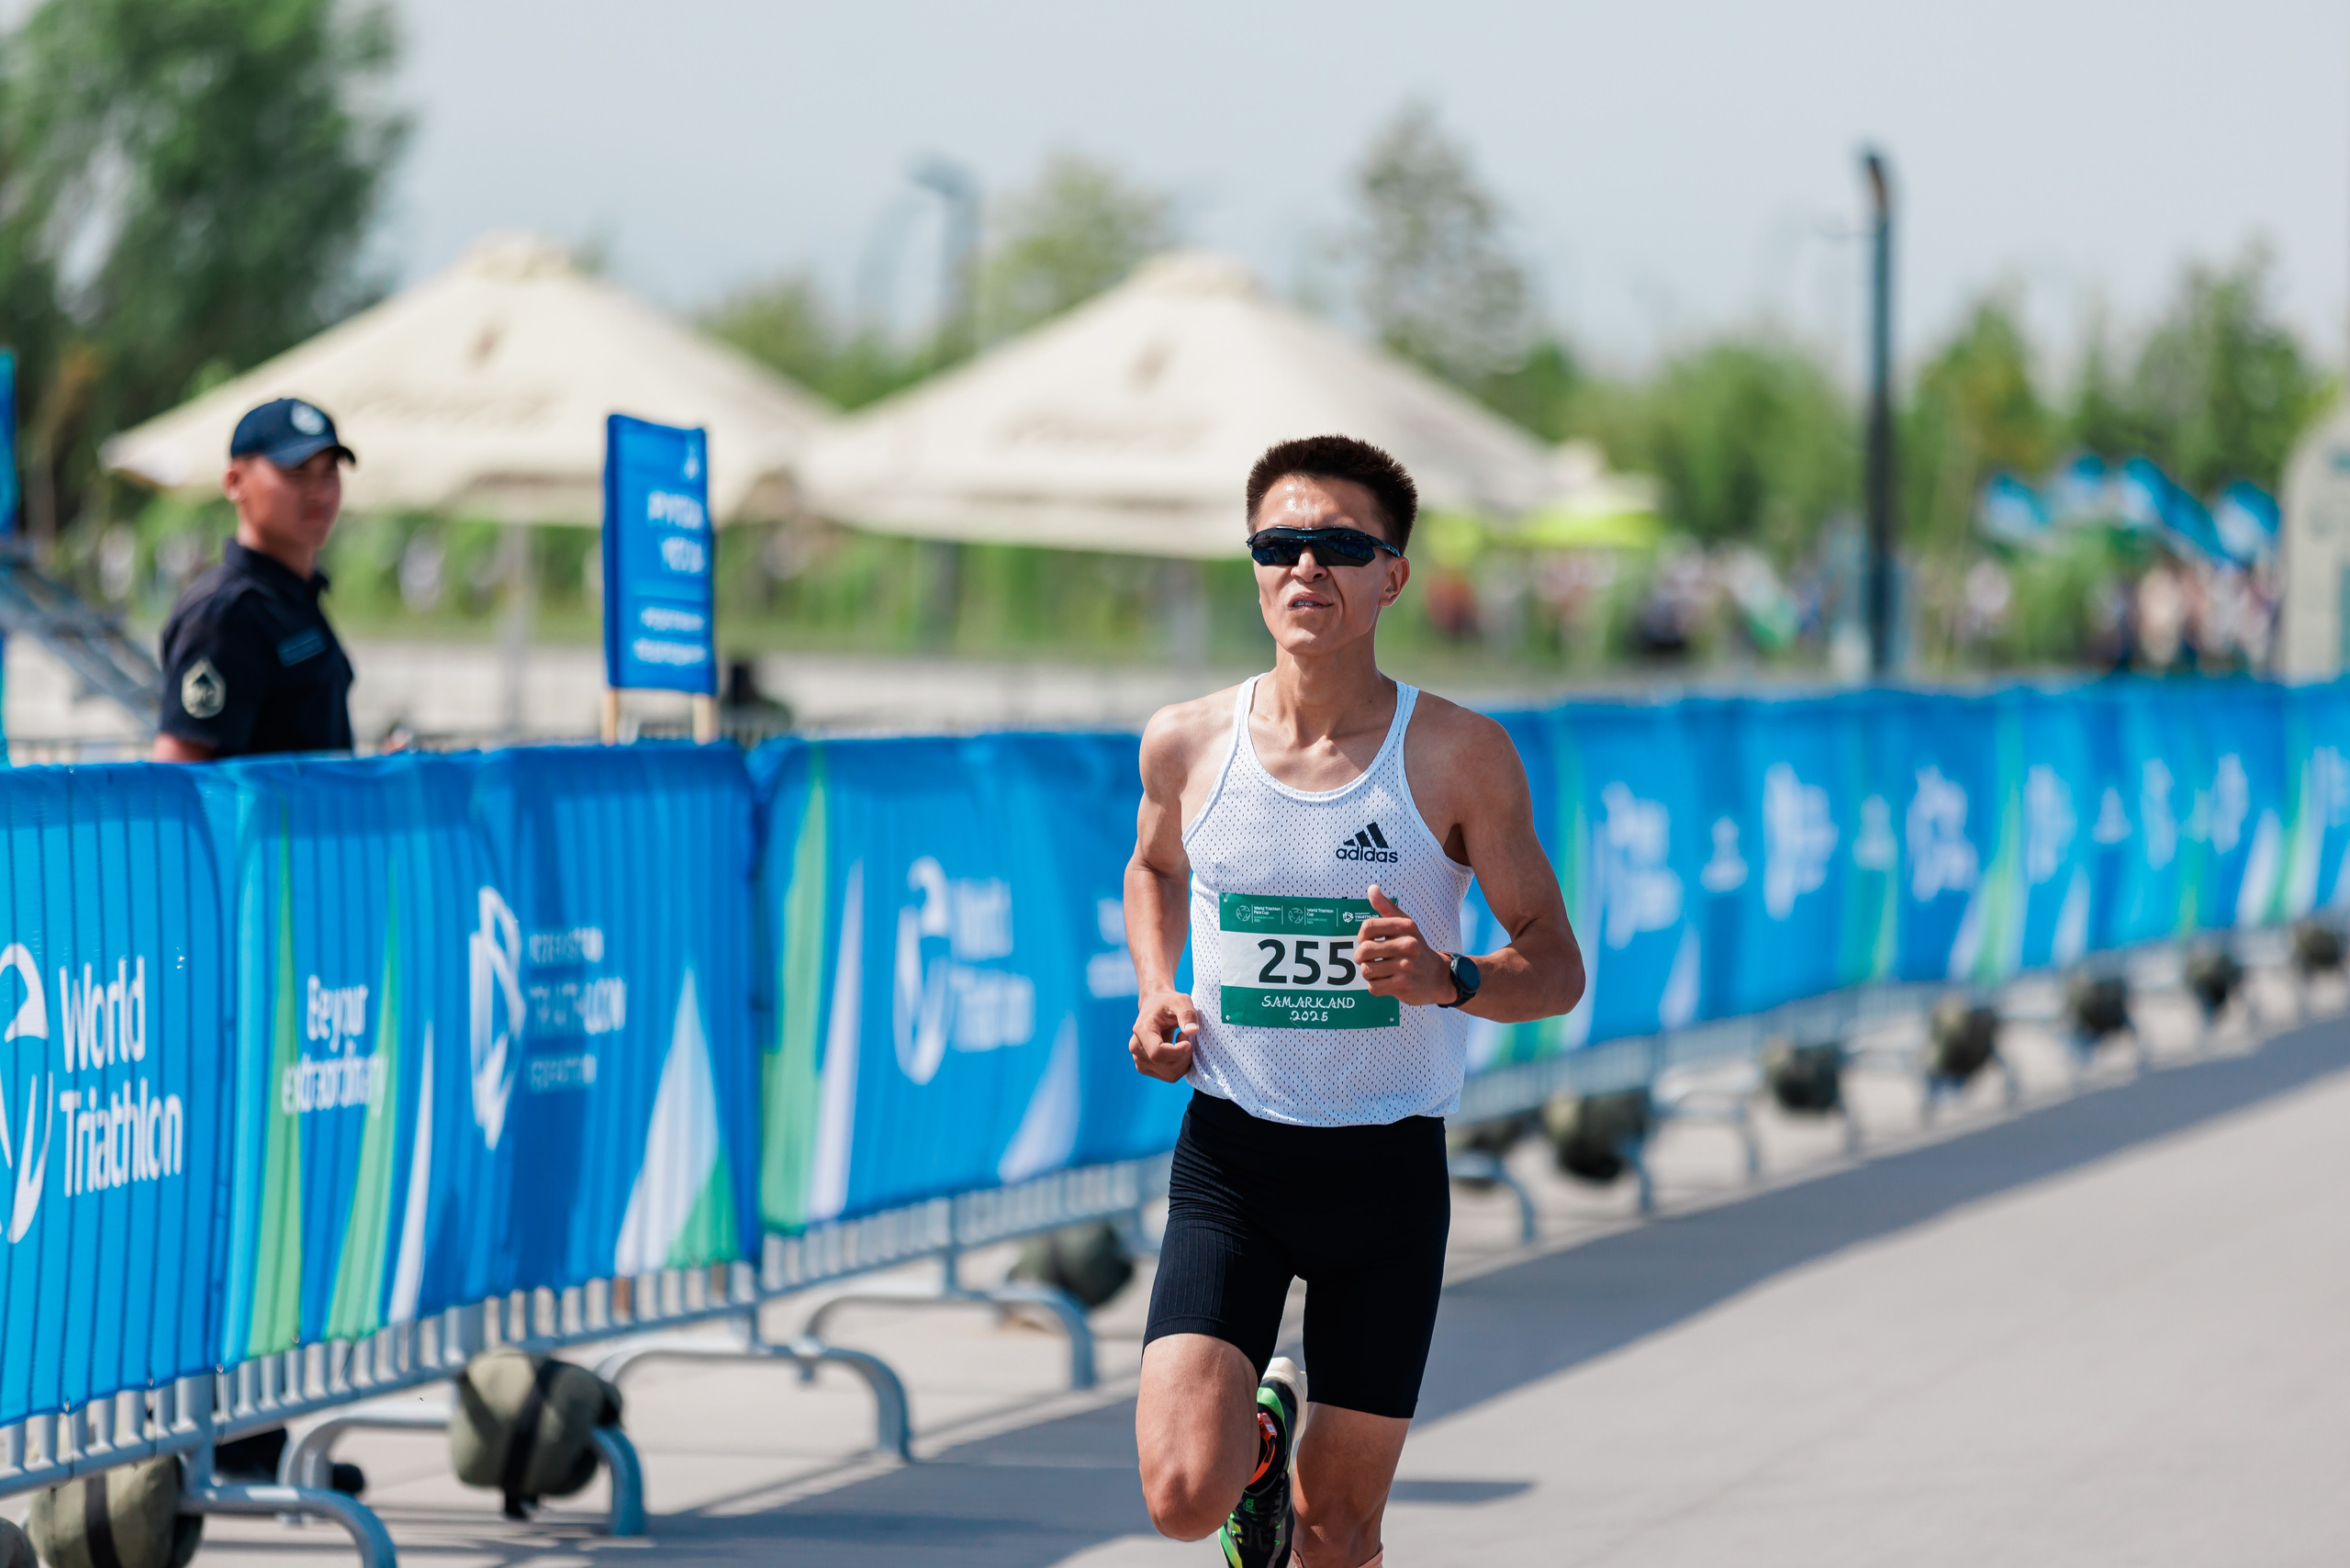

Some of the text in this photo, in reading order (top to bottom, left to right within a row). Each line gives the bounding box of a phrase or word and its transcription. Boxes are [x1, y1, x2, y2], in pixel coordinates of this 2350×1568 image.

[1336, 846, 1398, 863] adidas
[1258, 938, 1356, 986] 255
[59, 954, 146, 1073] World
[1261, 995, 1356, 1009] SAMARKAND
[1291, 1011, 1328, 1022] 2025
[59, 1076, 183, 1198] Triathlon
